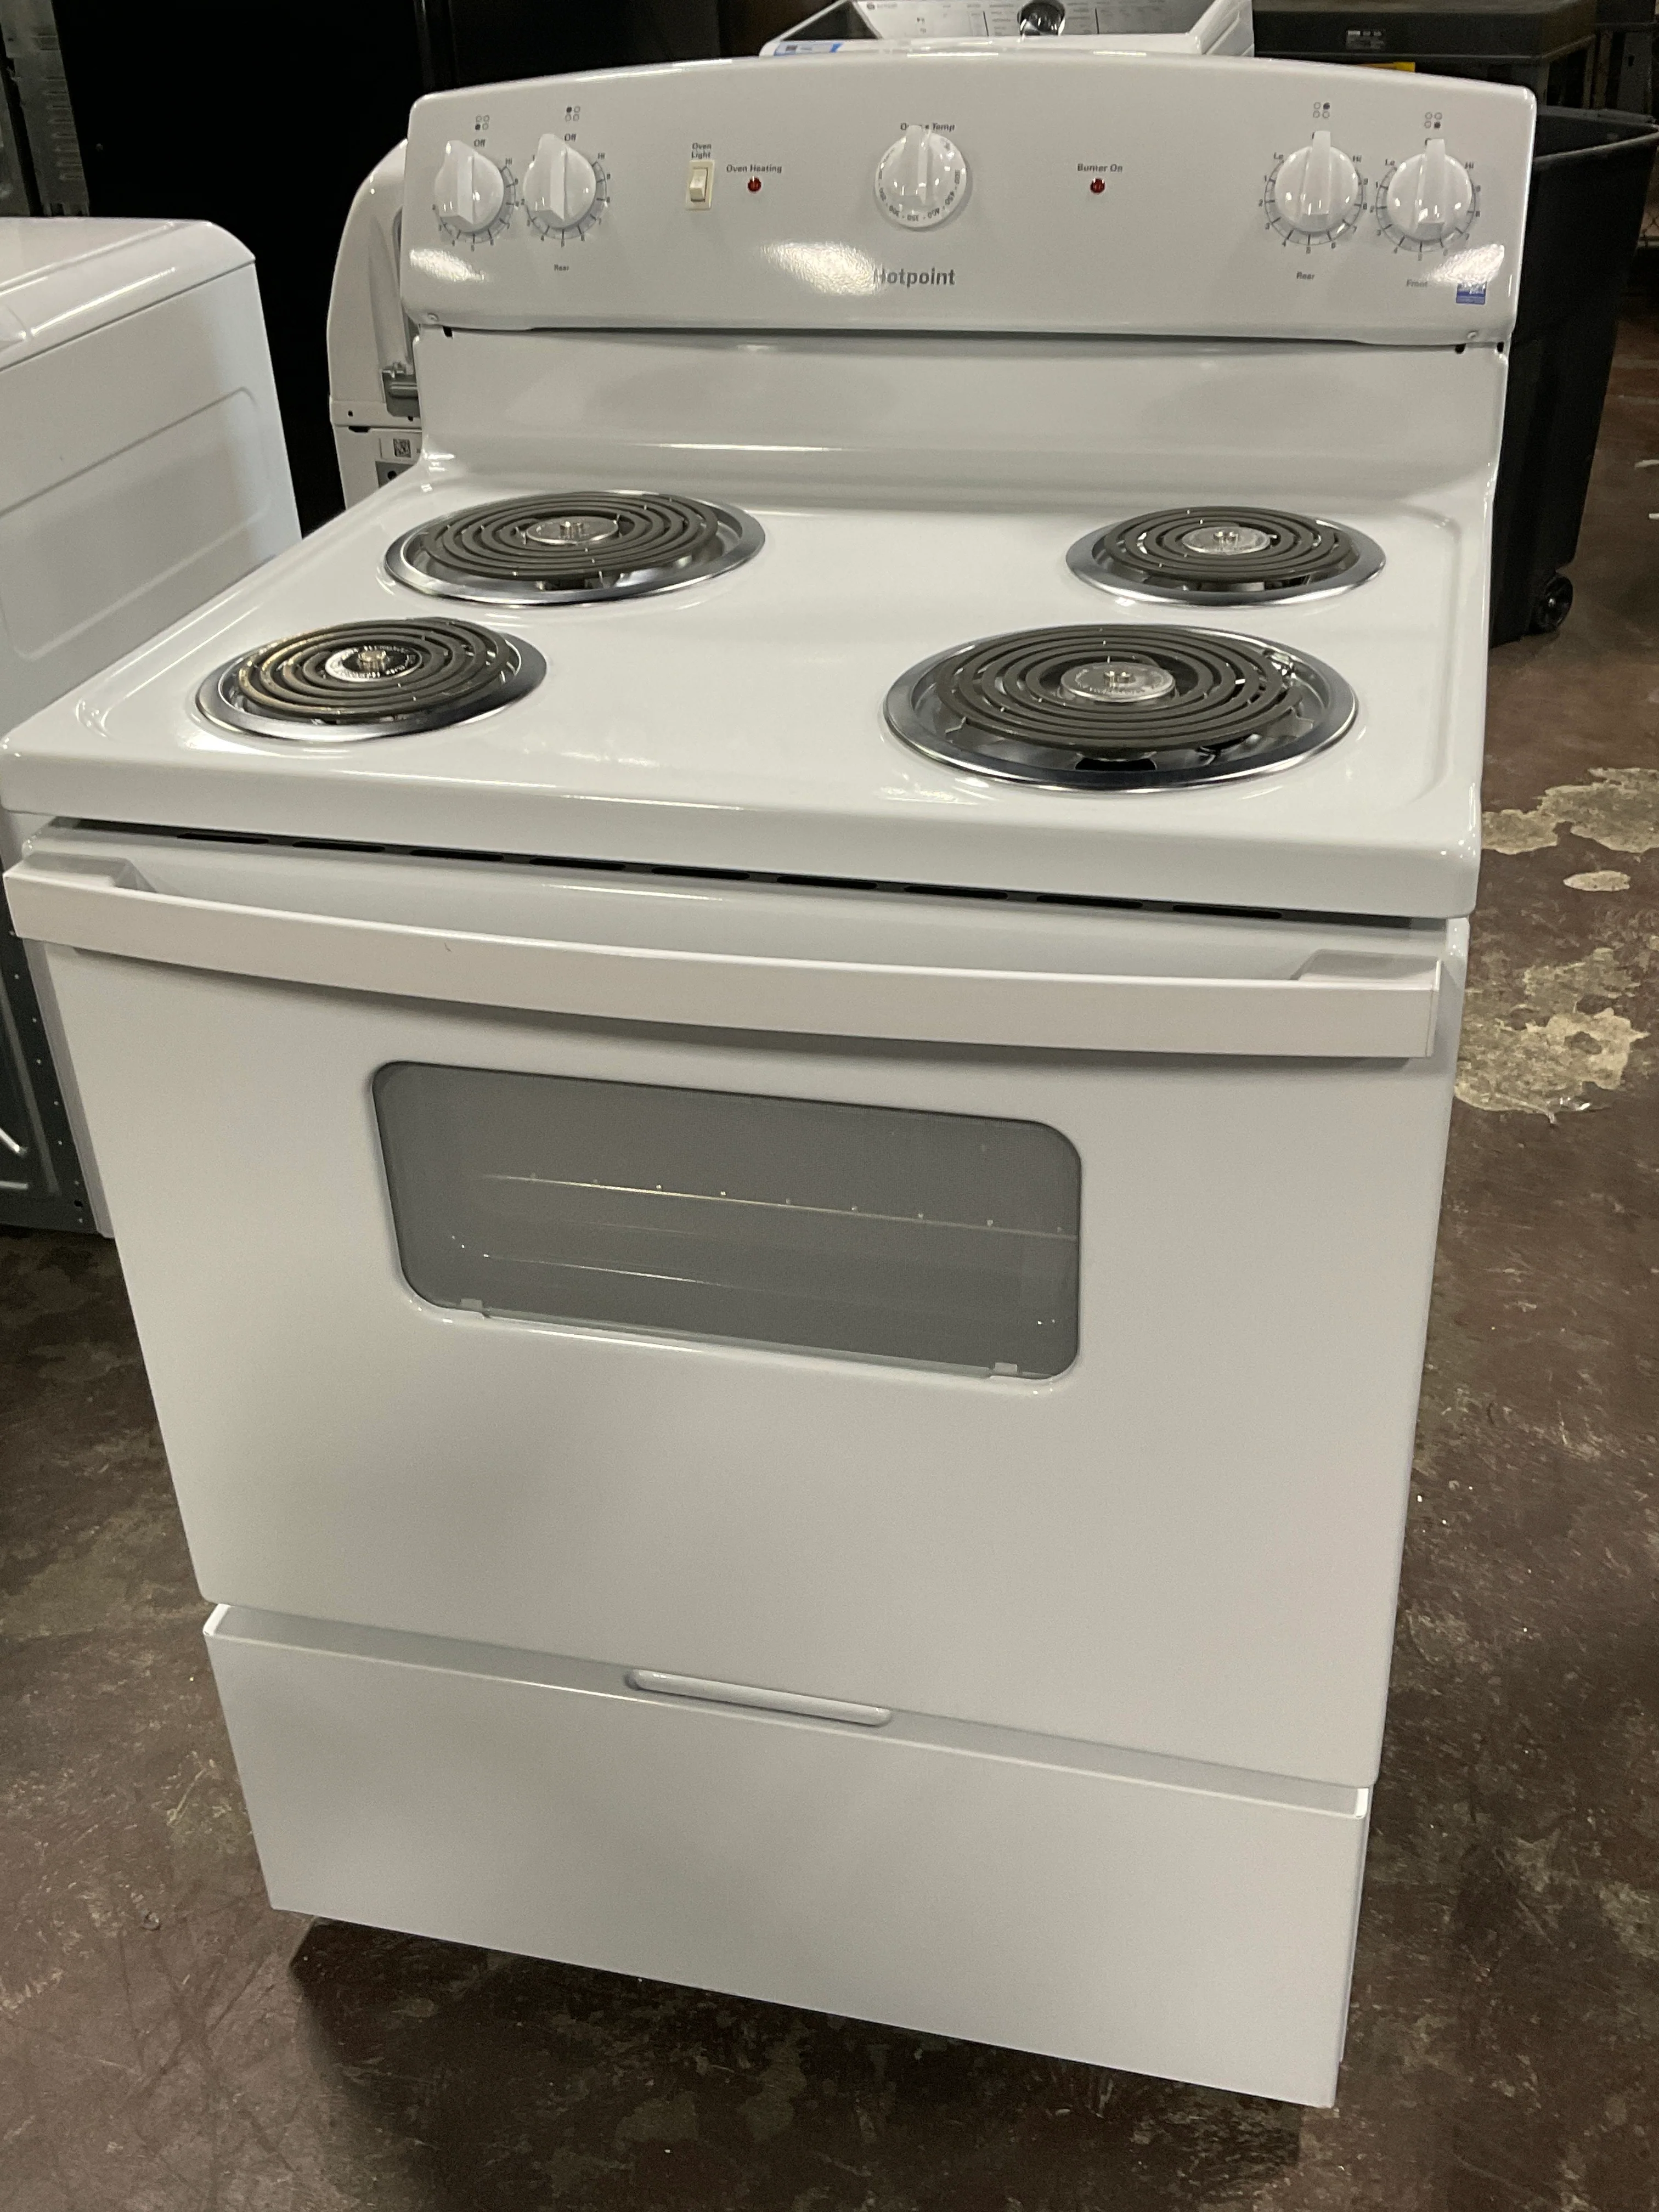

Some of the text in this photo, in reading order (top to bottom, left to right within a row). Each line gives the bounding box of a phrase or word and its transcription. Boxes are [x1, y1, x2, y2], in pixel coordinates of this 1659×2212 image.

[565, 133, 576, 142] Off
[474, 139, 486, 147] Off
[691, 151, 711, 160] Light
[726, 164, 782, 173] Oven Heating
[1110, 163, 1123, 172] On
[873, 266, 956, 287] Hotpoint
